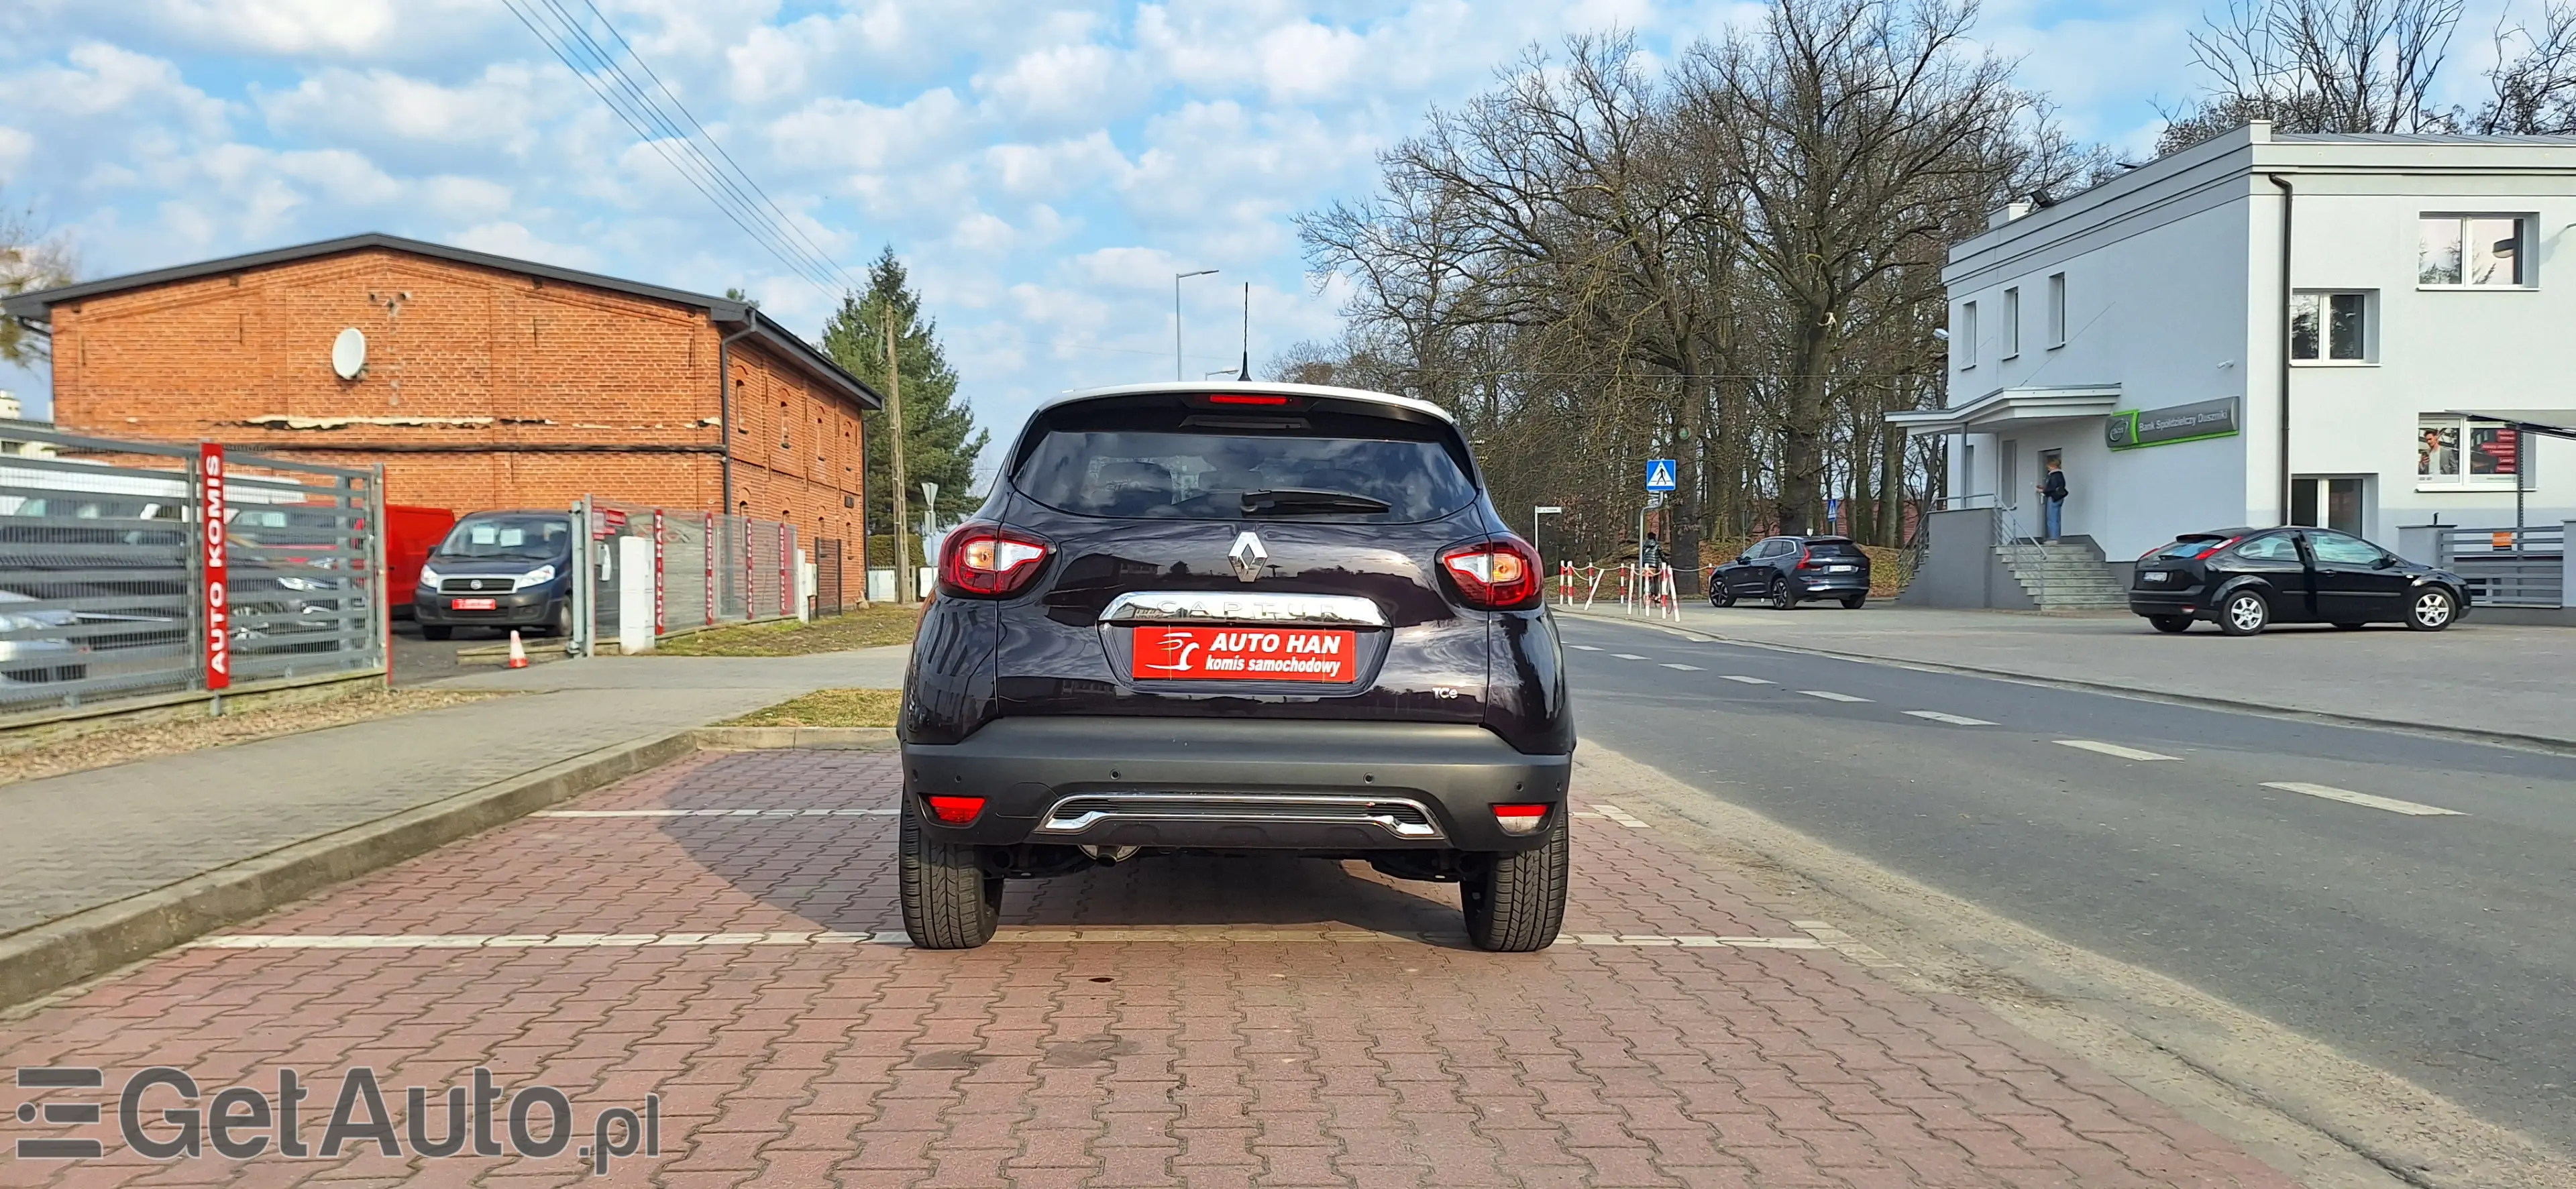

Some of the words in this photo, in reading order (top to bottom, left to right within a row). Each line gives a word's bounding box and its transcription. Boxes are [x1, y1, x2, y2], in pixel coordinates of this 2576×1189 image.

[2139, 420, 2155, 432] Bank
[206, 455, 223, 568] KOMIS
[1156, 600, 1338, 618] CAPTUR
[209, 581, 226, 675] AUTO
[1209, 632, 1280, 653] AUTO
[1285, 634, 1341, 654] HAN
[1205, 655, 1245, 671] komis
[1247, 655, 1341, 677] samochodowy
[1432, 687, 1458, 699] TCe
